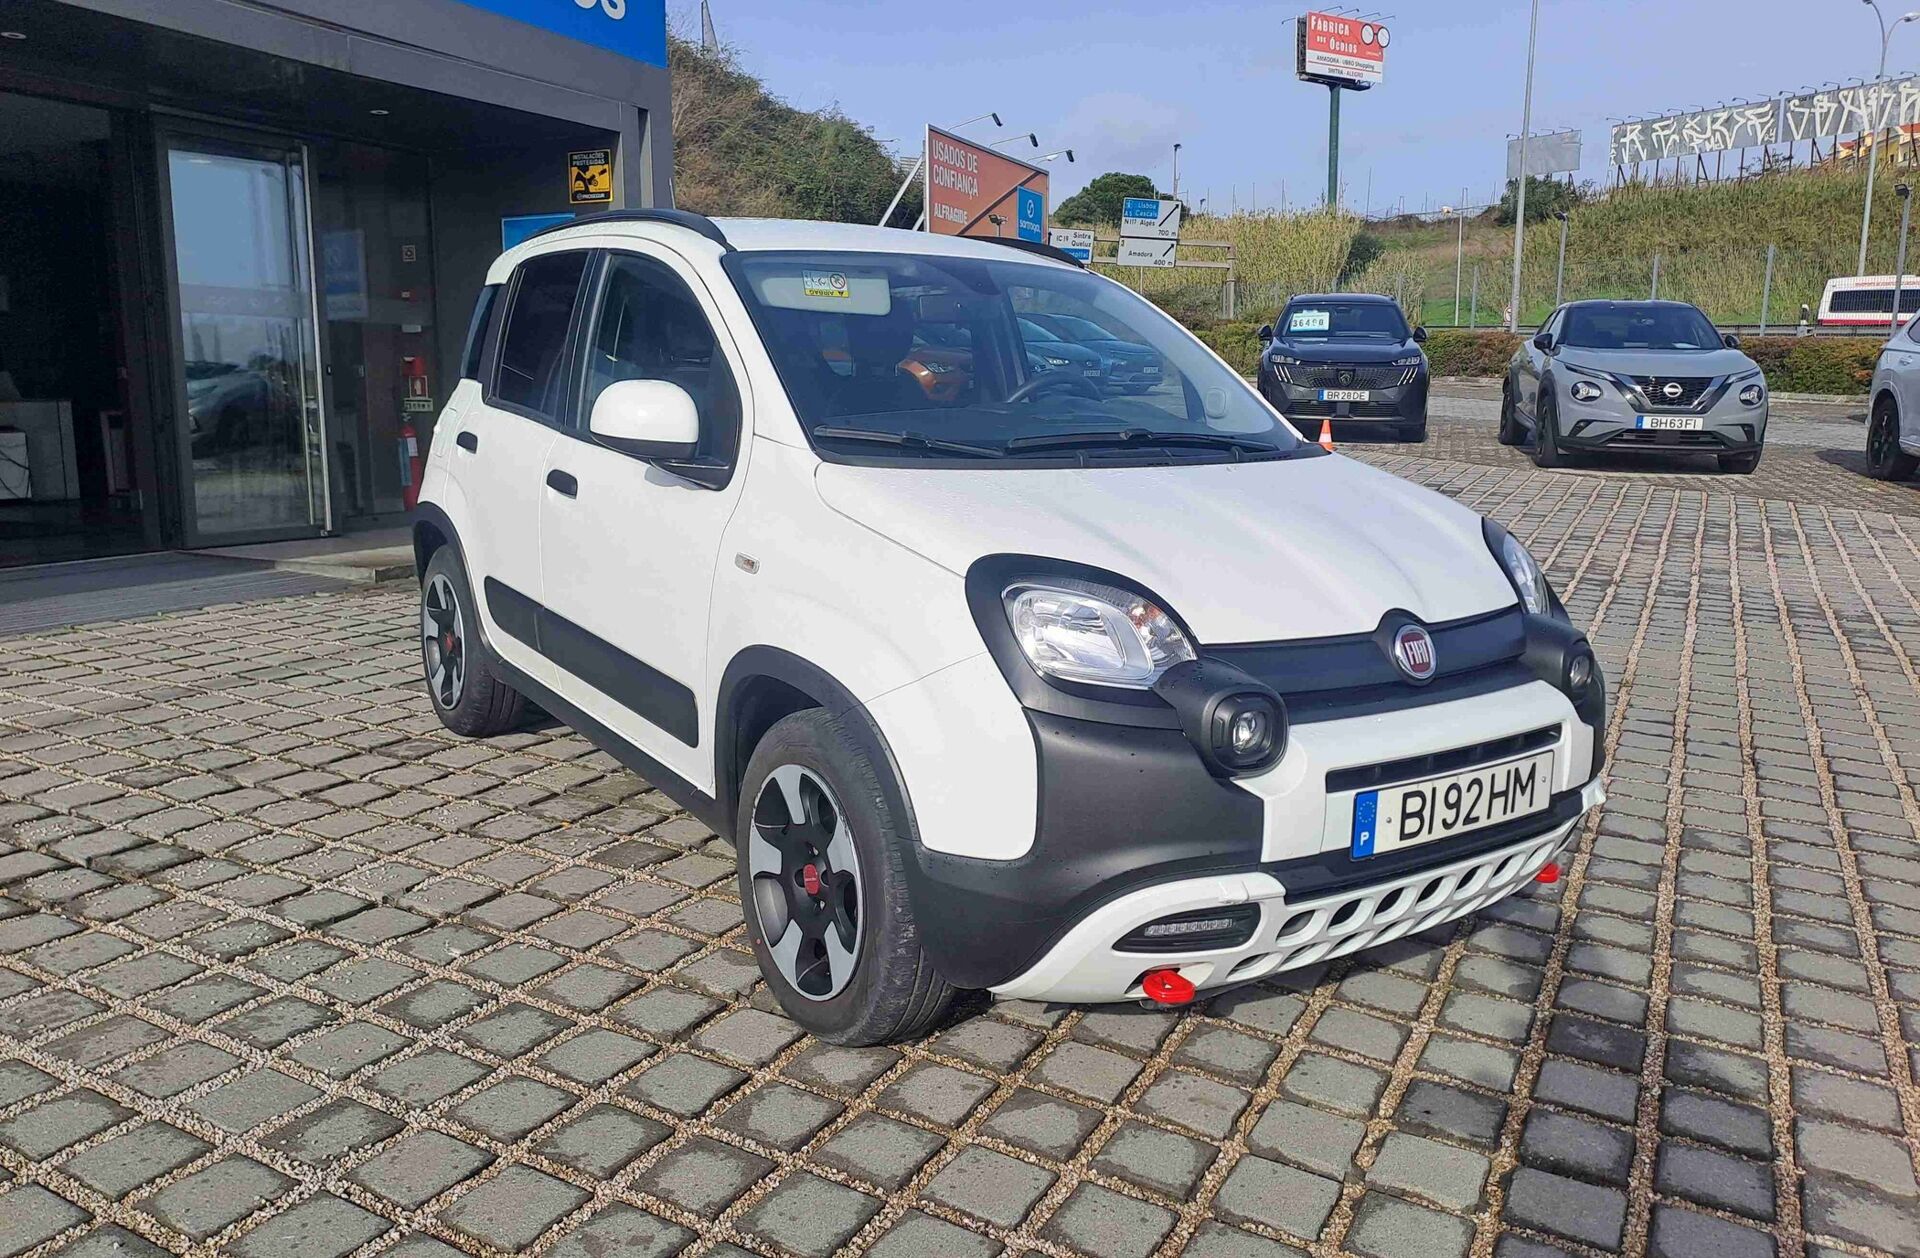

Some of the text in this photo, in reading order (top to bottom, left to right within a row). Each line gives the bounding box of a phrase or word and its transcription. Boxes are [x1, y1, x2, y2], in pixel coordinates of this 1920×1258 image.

[932, 139, 978, 173] USADOS DE
[933, 164, 979, 200] CONFIANÇA
[1138, 201, 1156, 210] Lisboa
[934, 203, 968, 225] ALFRAGIDE
[1073, 232, 1091, 240] Sintra
[1071, 240, 1092, 248] Queluz
[1128, 250, 1153, 258] Amadora
[1154, 258, 1166, 266] 400
[1404, 638, 1430, 666] FIAT
[1360, 831, 1370, 846] P
